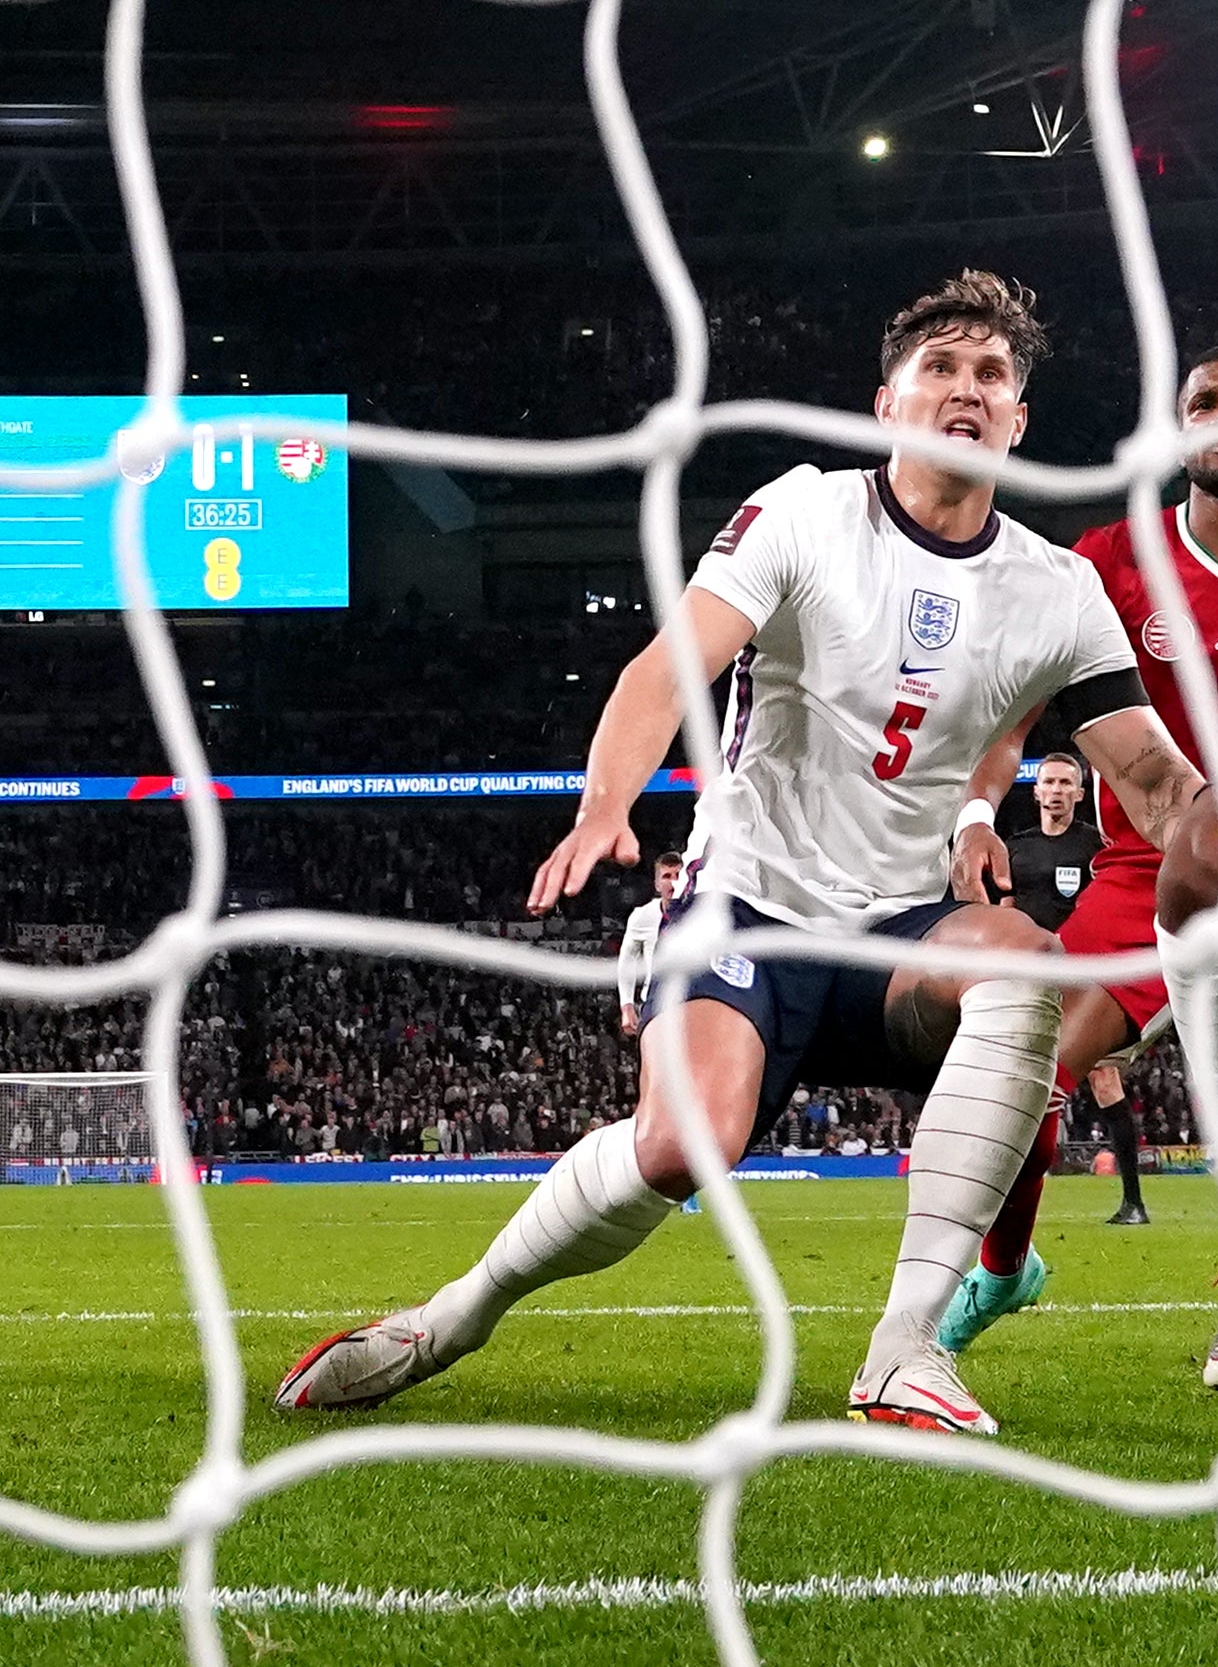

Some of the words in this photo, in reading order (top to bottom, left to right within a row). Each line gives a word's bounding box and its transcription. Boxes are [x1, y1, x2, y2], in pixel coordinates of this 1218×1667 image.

[192, 503, 251, 526] 36:25
[28, 611, 45, 622] LG
[871, 700, 928, 781] 5
[0, 781, 81, 797] CONTINUES
[282, 777, 363, 794] ENGLAND'S
[364, 777, 394, 793] FIFA
[395, 776, 449, 793] WORLD
[450, 775, 480, 792] CUP
[480, 774, 564, 794] QUALIFYING
[1058, 869, 1078, 877] FIFA
